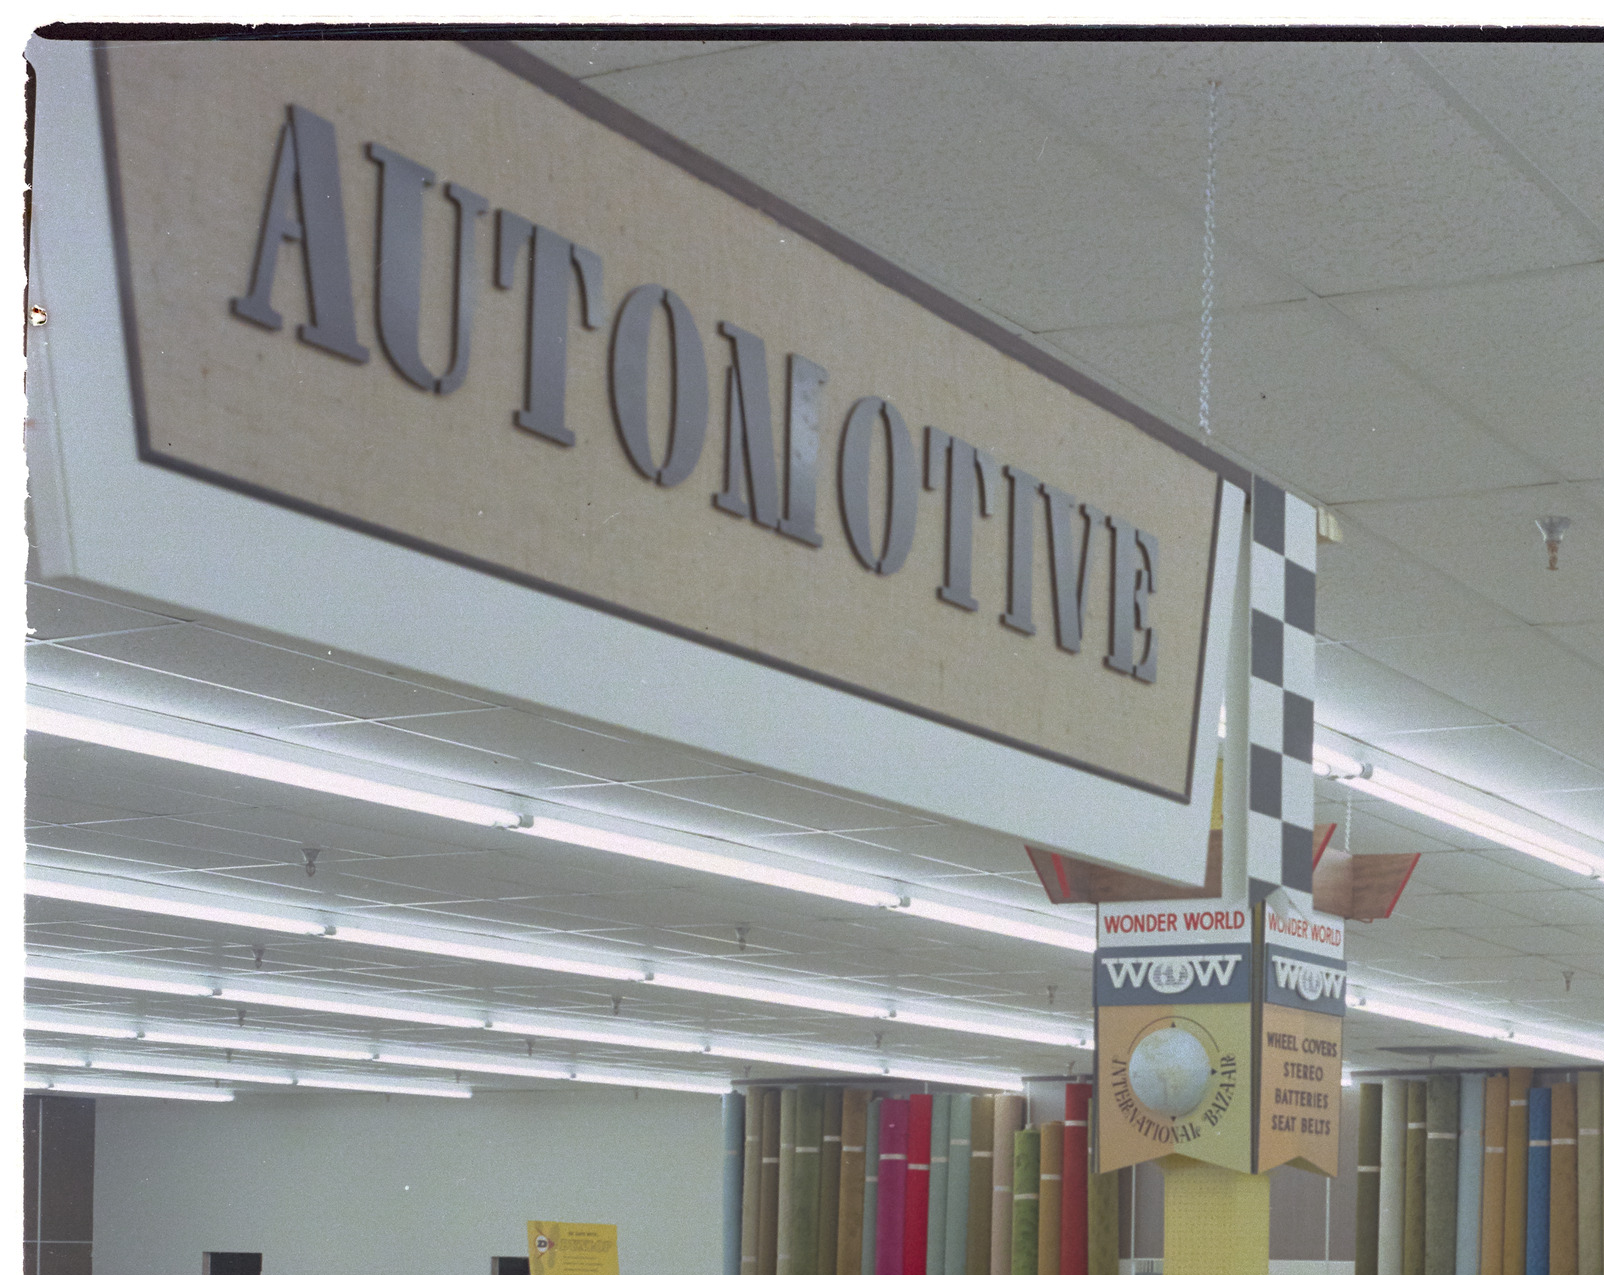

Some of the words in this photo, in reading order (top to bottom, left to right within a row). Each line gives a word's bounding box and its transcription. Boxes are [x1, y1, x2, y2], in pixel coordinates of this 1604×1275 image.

[231, 103, 1161, 684] AUTOMOTIVE
[1104, 914, 1177, 933] WONDER
[1184, 911, 1245, 931] WORLD
[1268, 912, 1308, 938] WONDER
[1311, 924, 1342, 946] WORLD
[1102, 954, 1242, 993] WOW
[1272, 955, 1346, 1000] WOW
[1266, 1032, 1299, 1051] WHEEL
[1302, 1038, 1338, 1057] COVERS
[1283, 1062, 1324, 1081] STEREO
[1111, 1055, 1201, 1144] INTERNATIONAL
[1203, 1053, 1237, 1127] BAZAAR
[1274, 1088, 1329, 1109] BATTERIES
[1271, 1115, 1296, 1133] SEAT
[1301, 1118, 1331, 1136] BELTS
